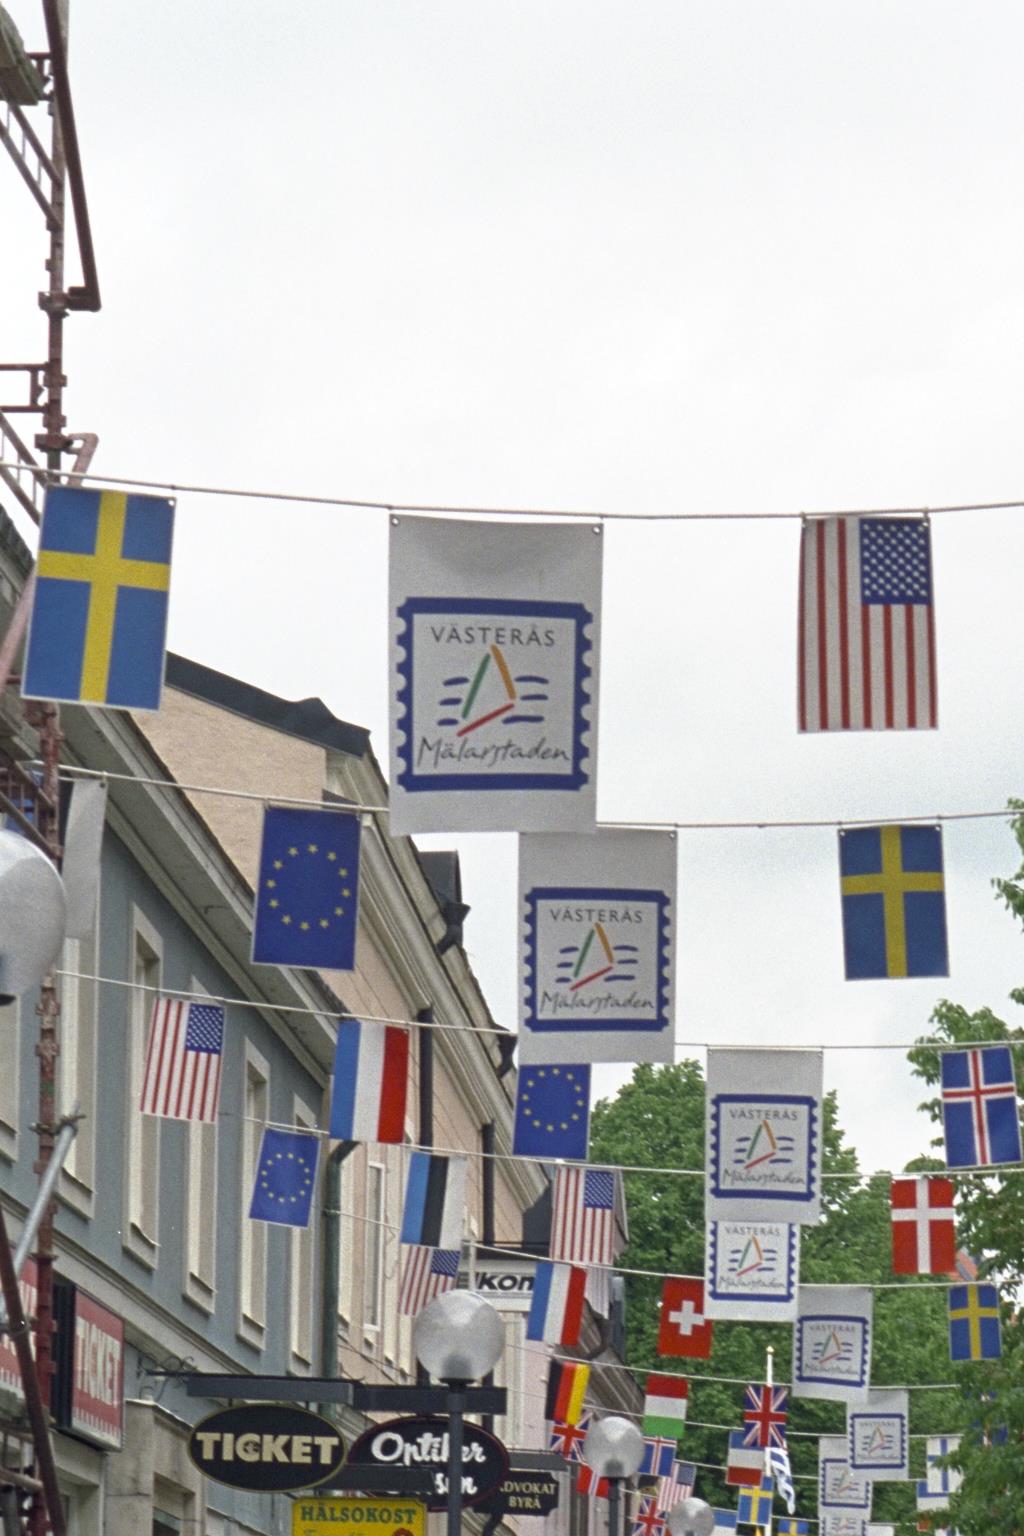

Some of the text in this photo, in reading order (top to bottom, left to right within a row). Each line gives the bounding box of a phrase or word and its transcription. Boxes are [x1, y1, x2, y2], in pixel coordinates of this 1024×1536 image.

[431, 624, 556, 647] VÄSTERÅS
[417, 737, 570, 769] Mälarstaden
[550, 906, 643, 923] VÄSTERÅS
[540, 990, 655, 1014] Mälarstaden
[75, 1313, 121, 1410] TICKET
[196, 1432, 339, 1465] TICKET
[500, 1481, 557, 1495] DVOKAT
[301, 1503, 416, 1524] HÄLSOKOST
[508, 1495, 542, 1510] BYRÅ
